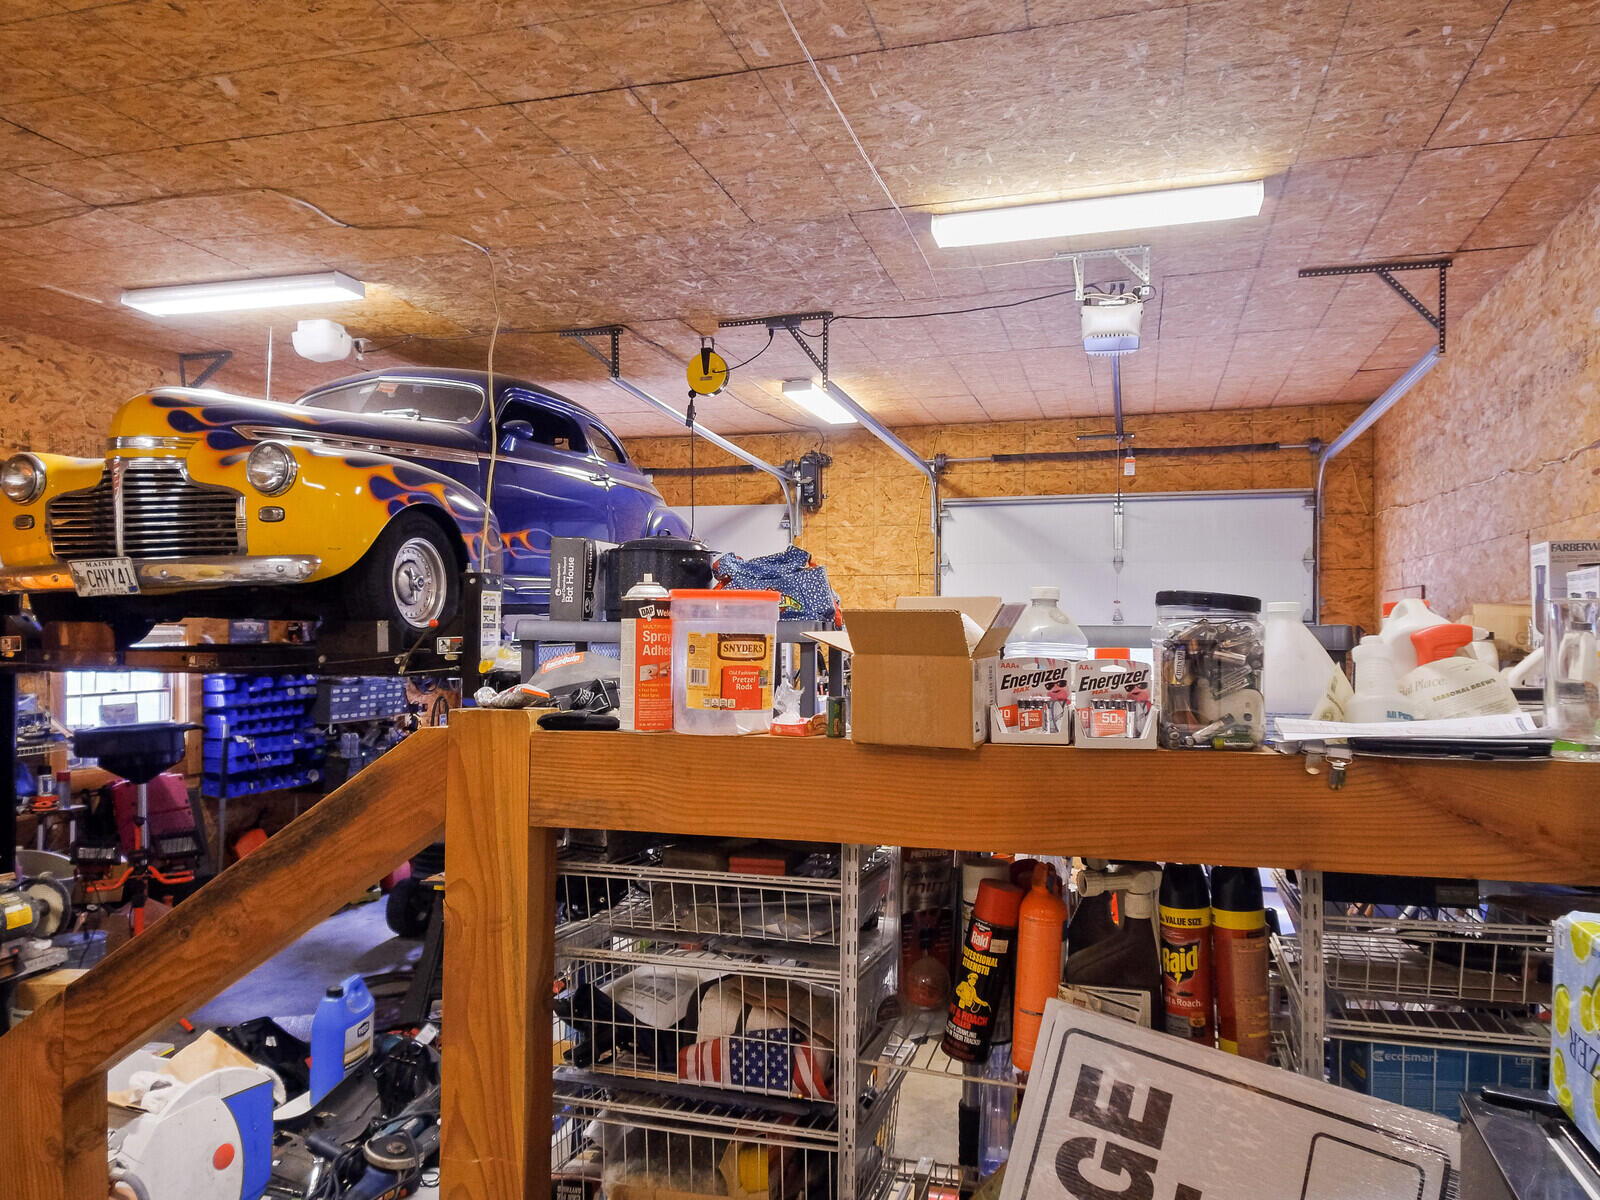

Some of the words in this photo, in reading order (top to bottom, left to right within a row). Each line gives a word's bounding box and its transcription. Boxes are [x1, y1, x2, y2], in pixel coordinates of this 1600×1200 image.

[566, 556, 575, 585] House
[565, 586, 574, 603] Bat
[641, 607, 653, 616] DAP
[642, 630, 671, 645] Spray
[732, 676, 756, 684] Pretzel
[736, 683, 753, 691] Rods
[1000, 667, 1068, 691] Energizer
[1078, 669, 1149, 692] Energizer
[1166, 915, 1186, 925] VALUE
[1187, 917, 1202, 926] SIZE
[971, 930, 989, 948] Raid
[1162, 945, 1198, 973] Raid
[1177, 998, 1201, 1008] Roach
